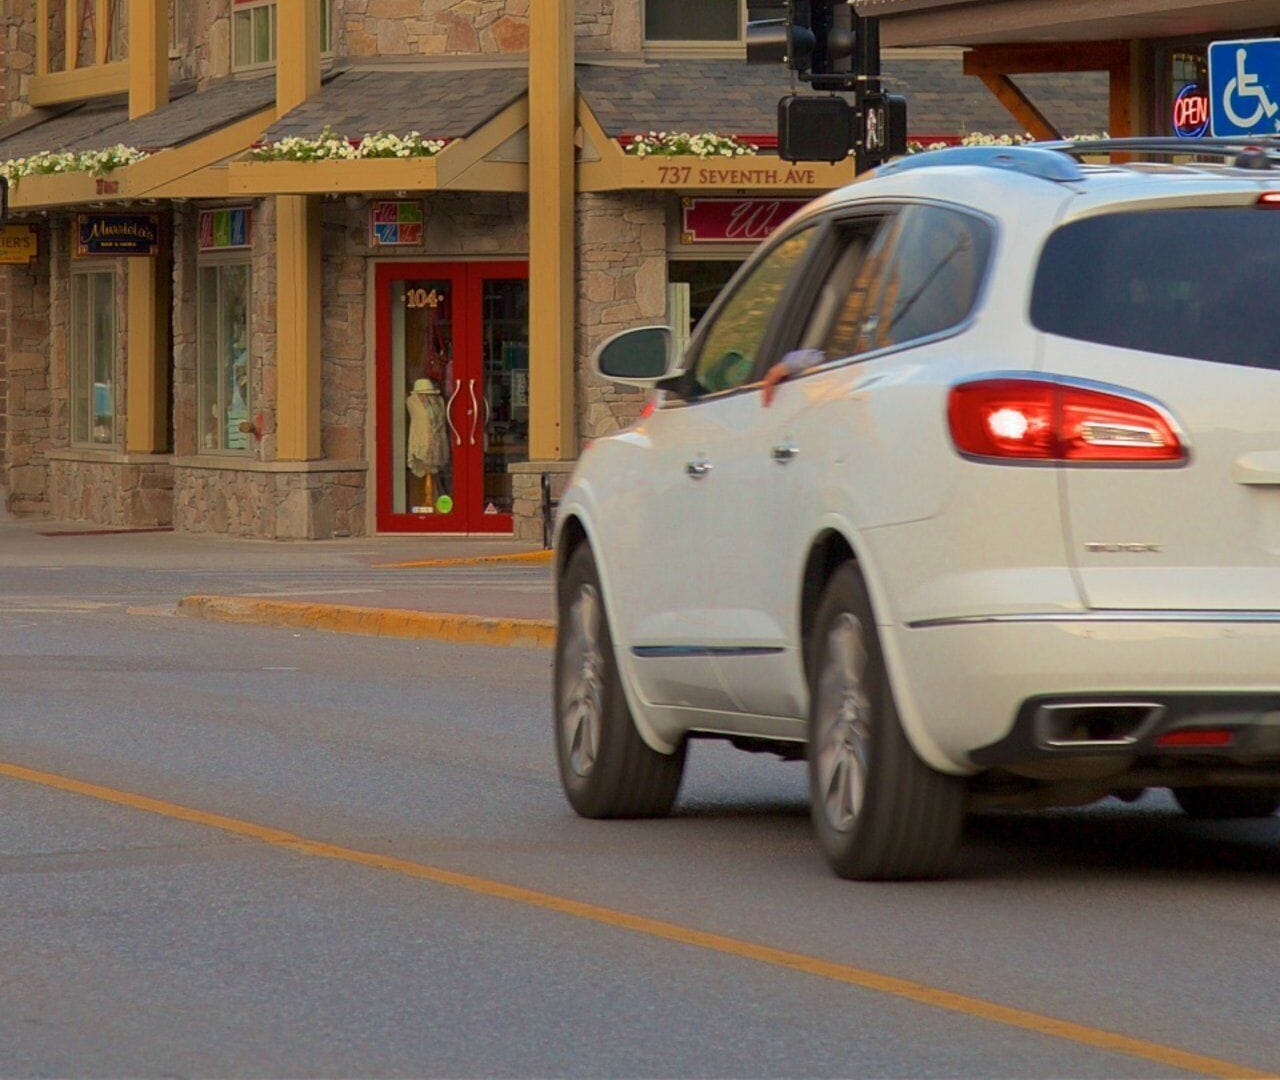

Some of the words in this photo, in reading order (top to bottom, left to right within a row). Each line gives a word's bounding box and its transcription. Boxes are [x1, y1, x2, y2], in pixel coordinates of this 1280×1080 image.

[1174, 97, 1208, 127] OPEN
[658, 167, 692, 184] 737
[699, 167, 777, 184] SEVENTH
[785, 167, 816, 184] AVE
[407, 289, 438, 308] 104
